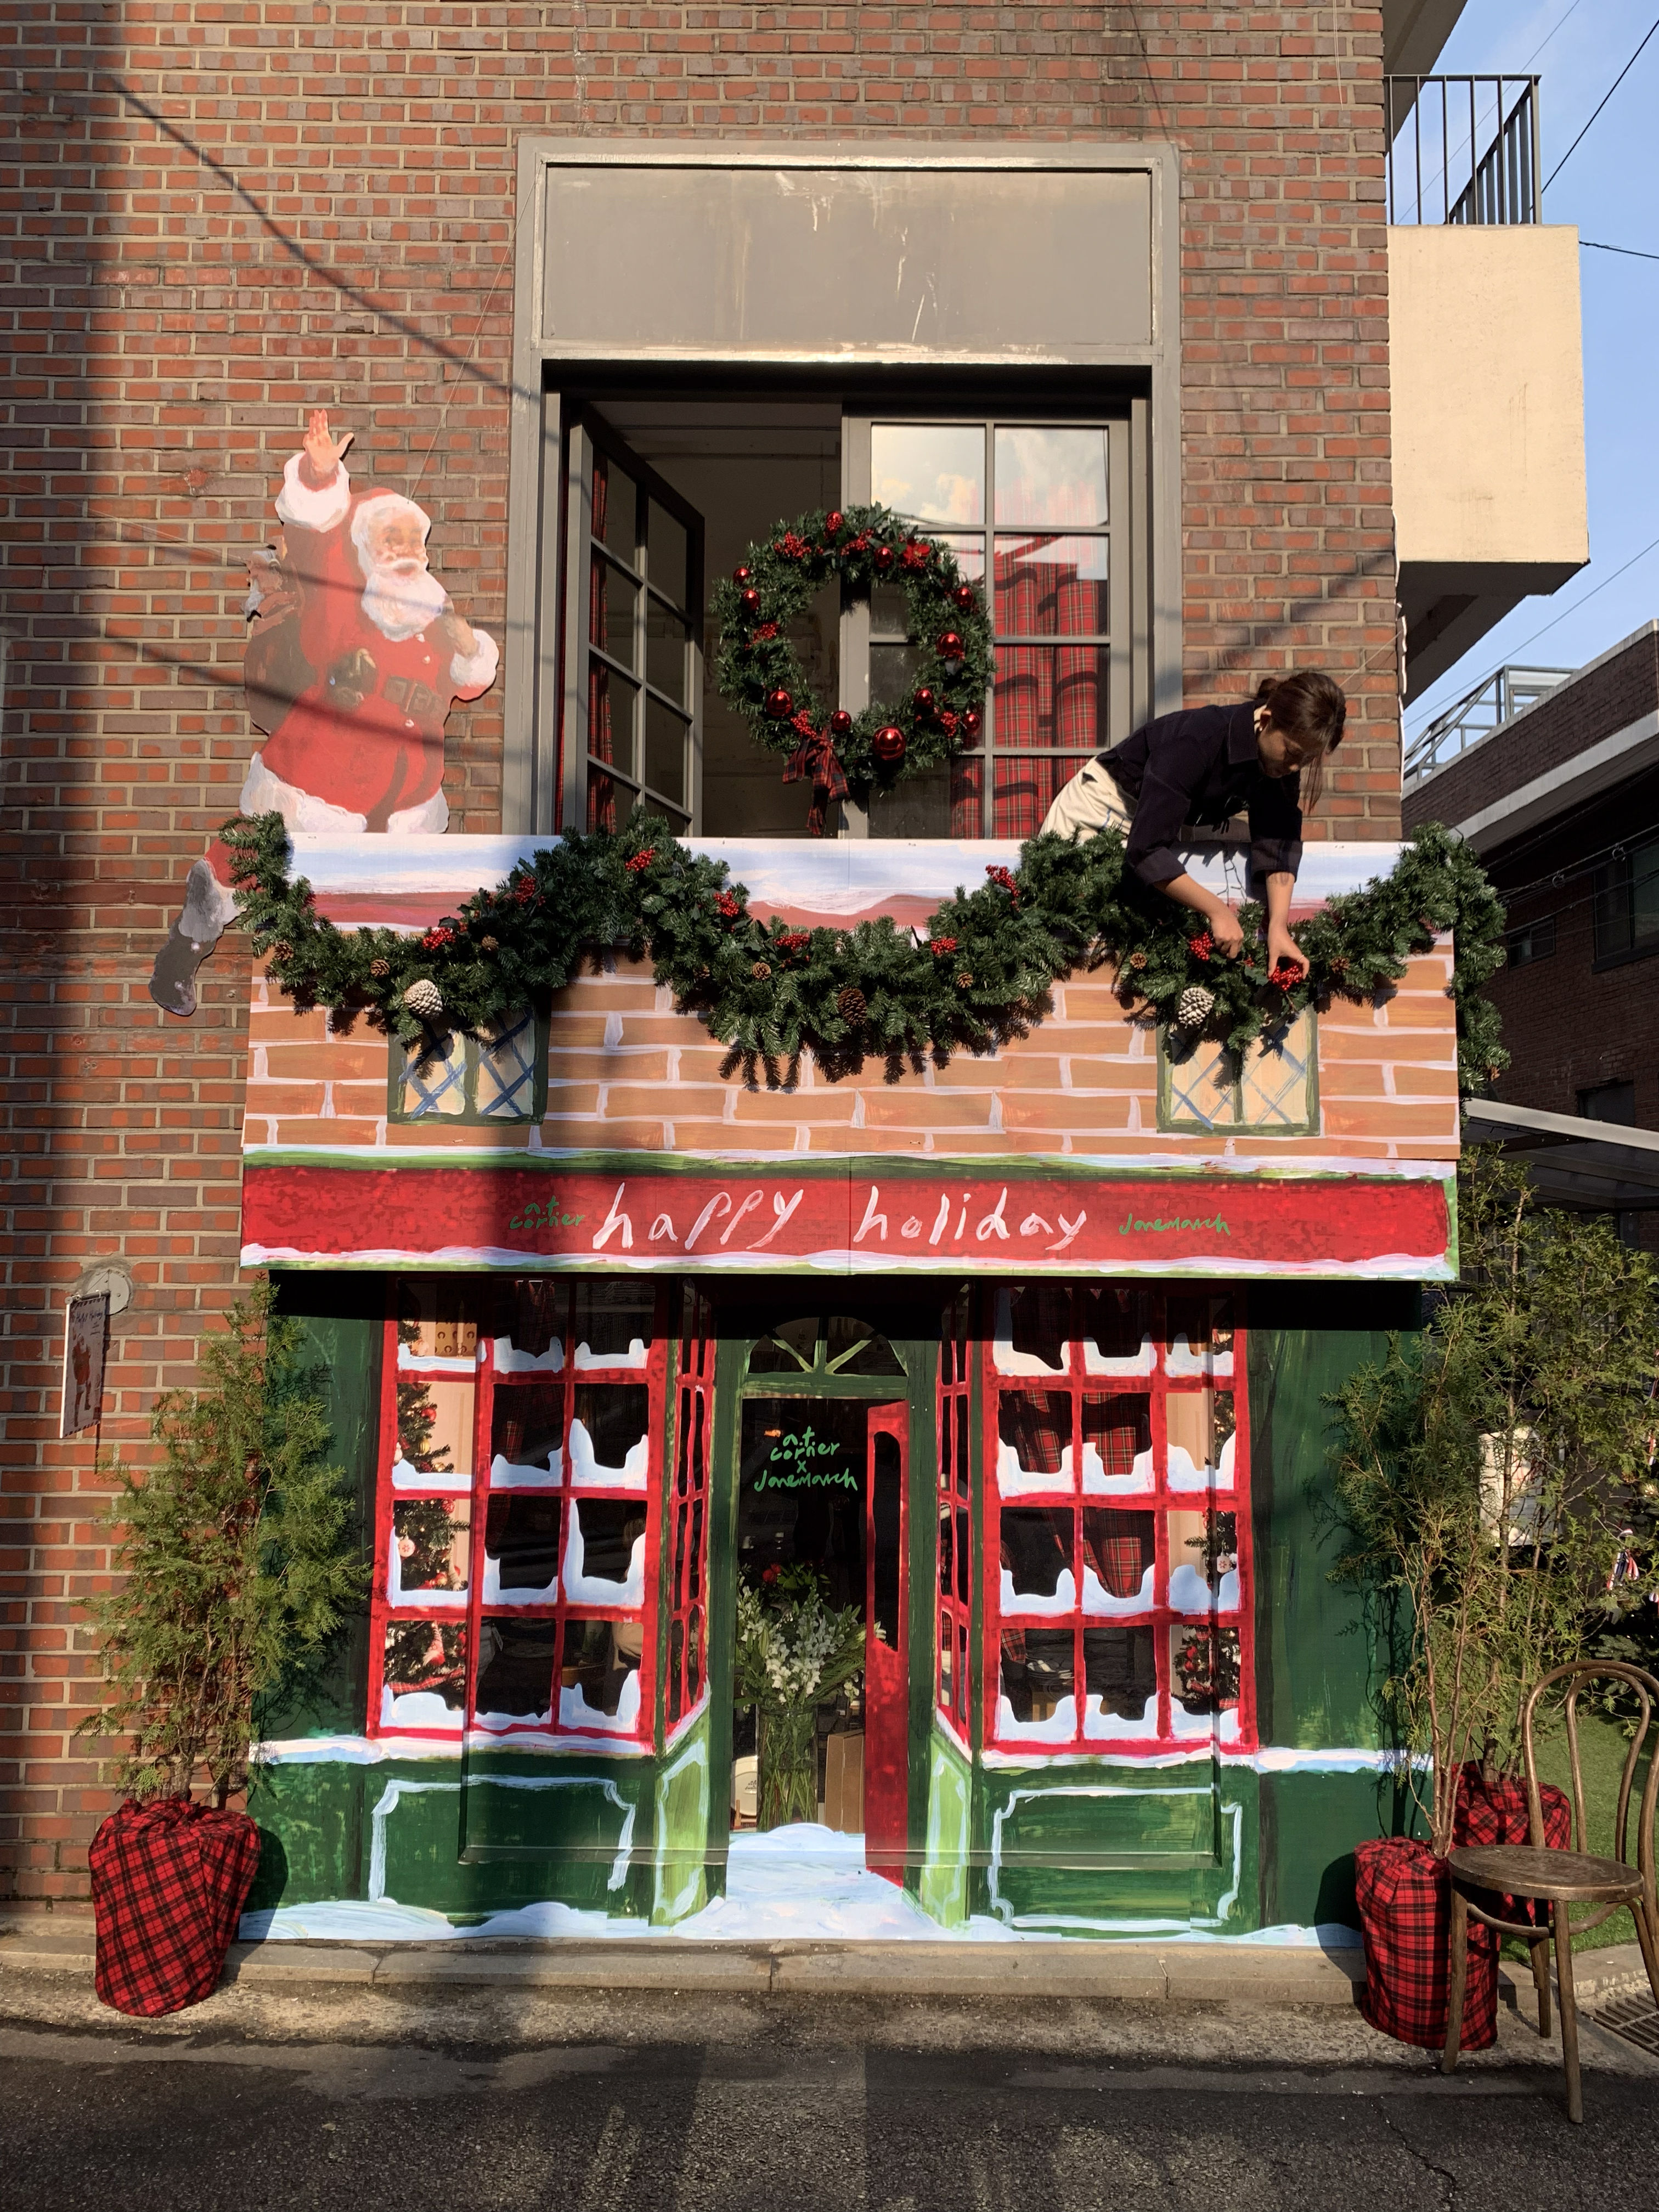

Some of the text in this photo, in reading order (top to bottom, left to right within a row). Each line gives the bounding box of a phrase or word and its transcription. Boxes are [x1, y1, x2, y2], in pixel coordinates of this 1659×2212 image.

[509, 1213, 586, 1229] corner
[592, 1182, 1087, 1251] happy holiday
[770, 1442, 840, 1462] corner
